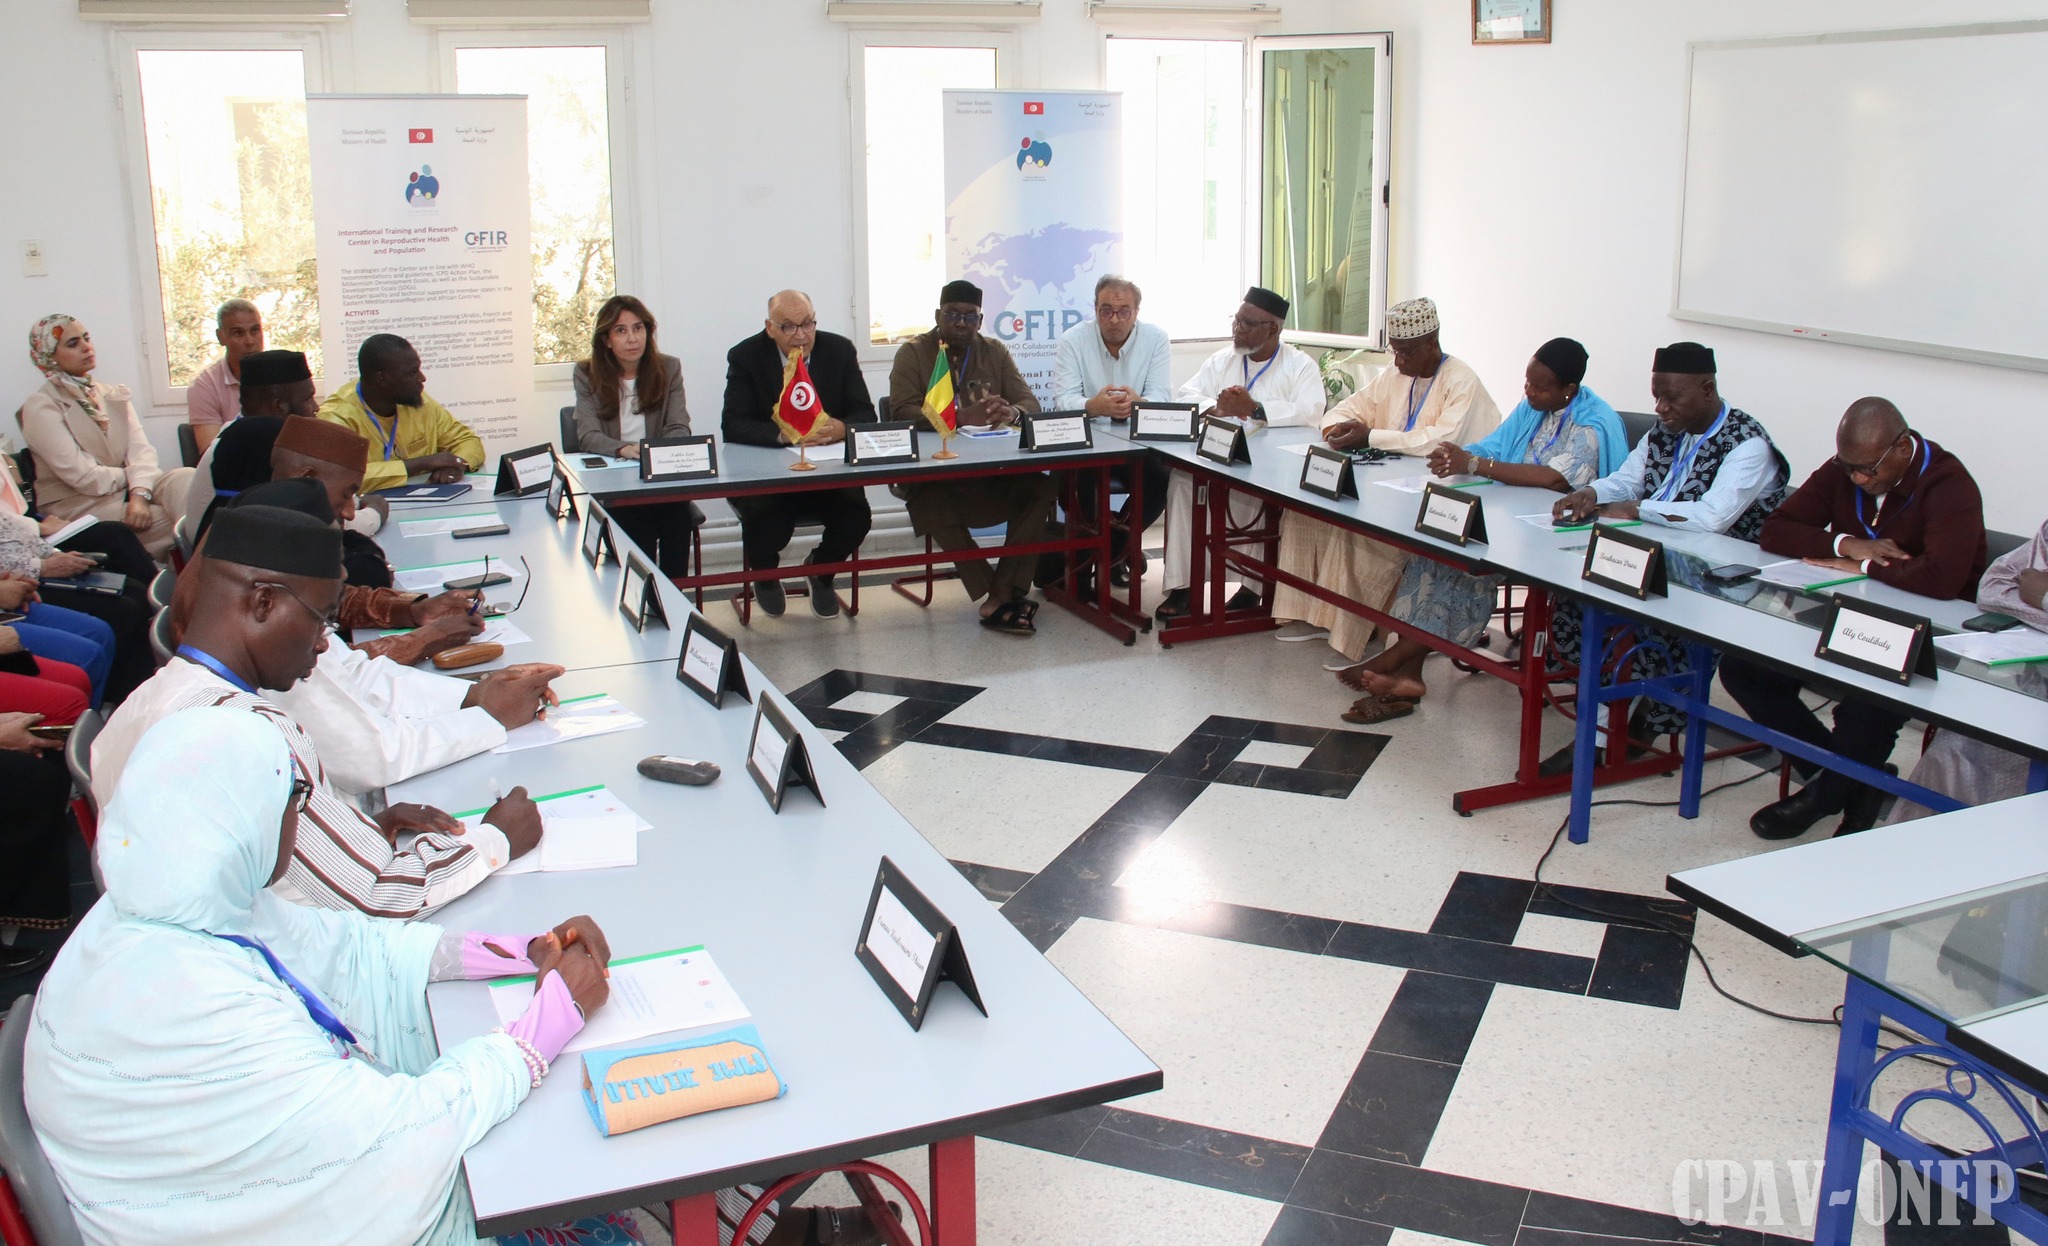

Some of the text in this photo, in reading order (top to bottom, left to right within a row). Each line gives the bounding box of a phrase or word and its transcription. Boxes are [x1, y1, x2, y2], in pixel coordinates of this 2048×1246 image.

[338, 228, 383, 236] International
[381, 237, 426, 245] Reproductive
[388, 246, 426, 254] Population
[1842, 627, 1891, 652] Aly Coulibaly
[707, 1052, 768, 1082] MME
